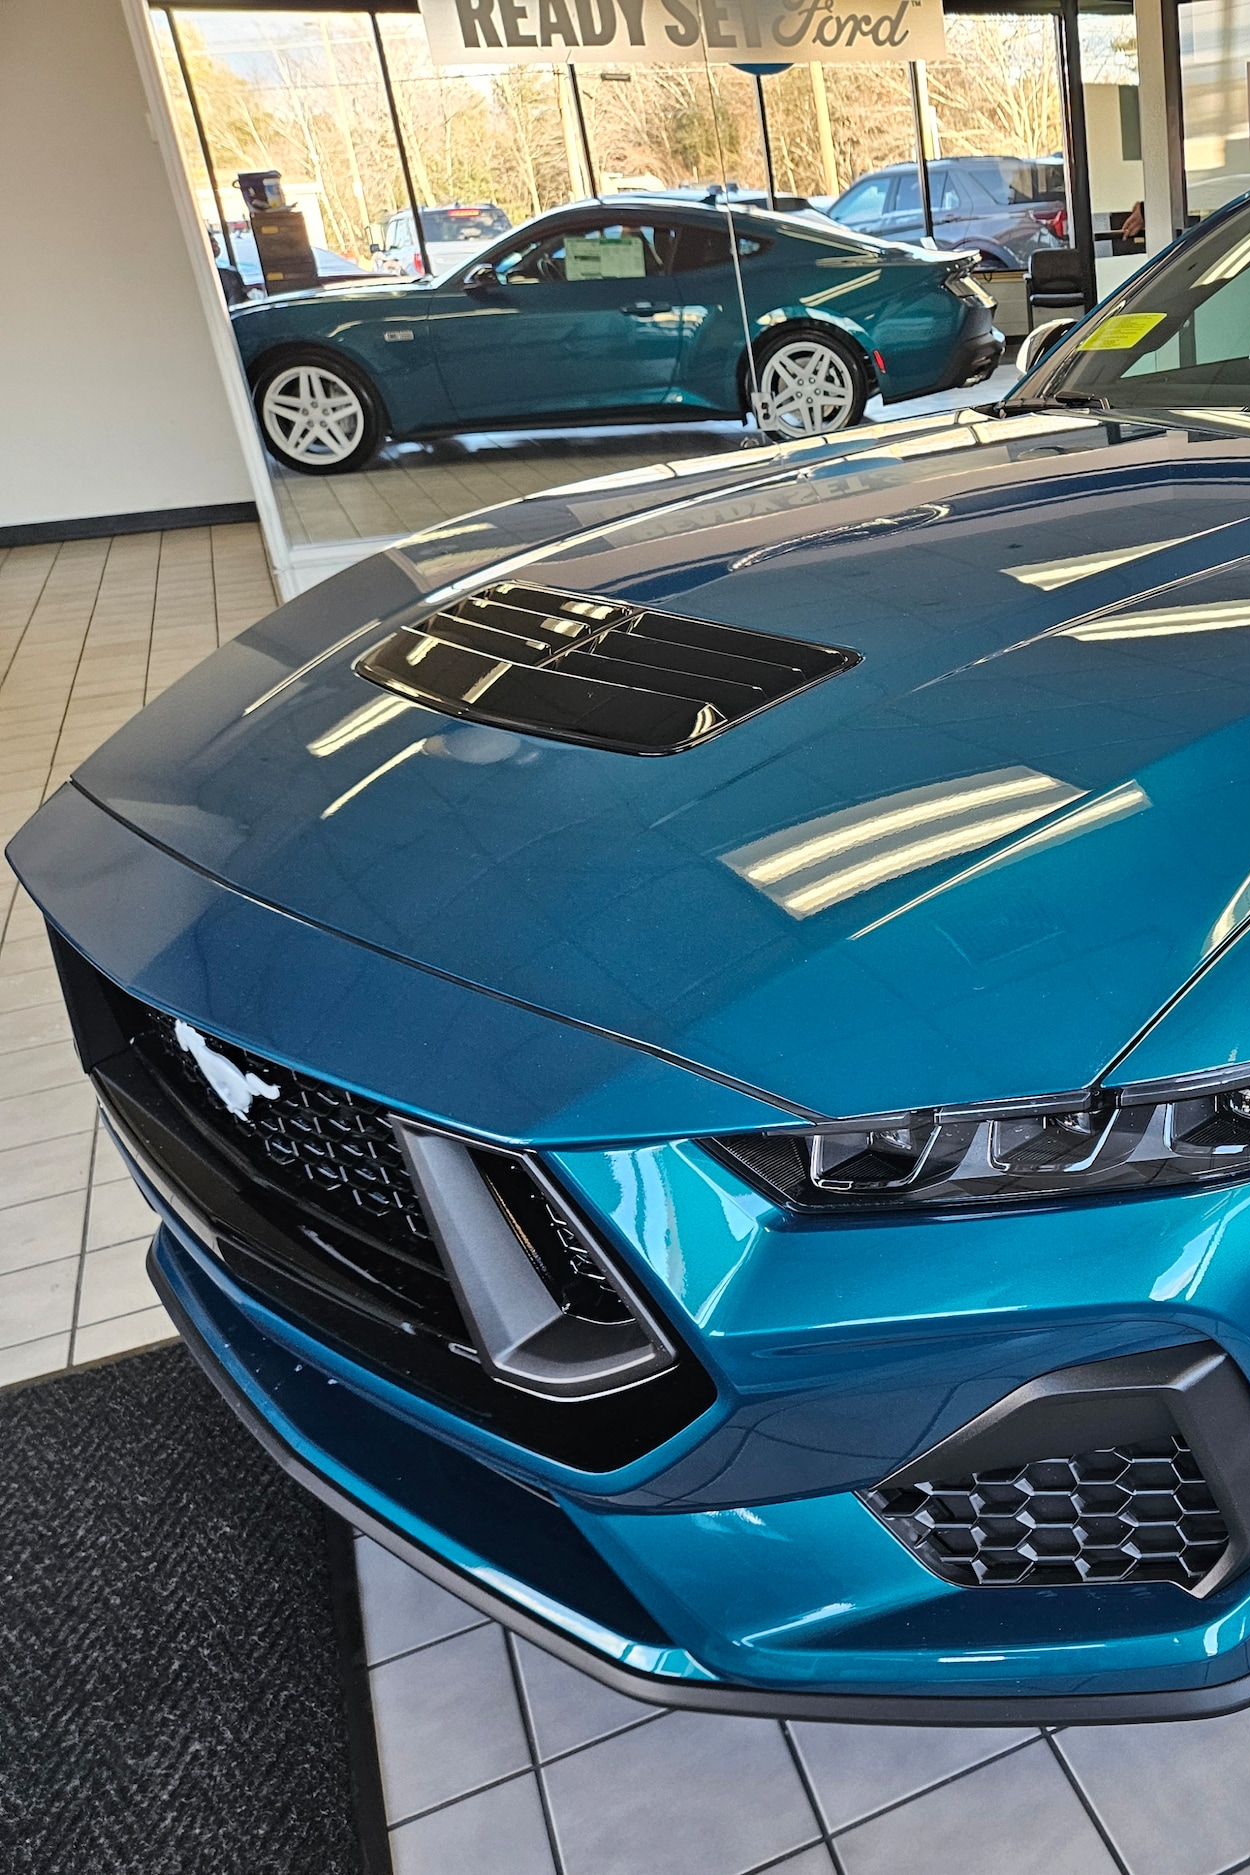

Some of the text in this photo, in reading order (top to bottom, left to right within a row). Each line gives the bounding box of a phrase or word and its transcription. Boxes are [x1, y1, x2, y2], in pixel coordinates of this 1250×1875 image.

[456, 0, 646, 48] READY
[661, 0, 764, 48] SET
[771, 0, 909, 47] Ford
